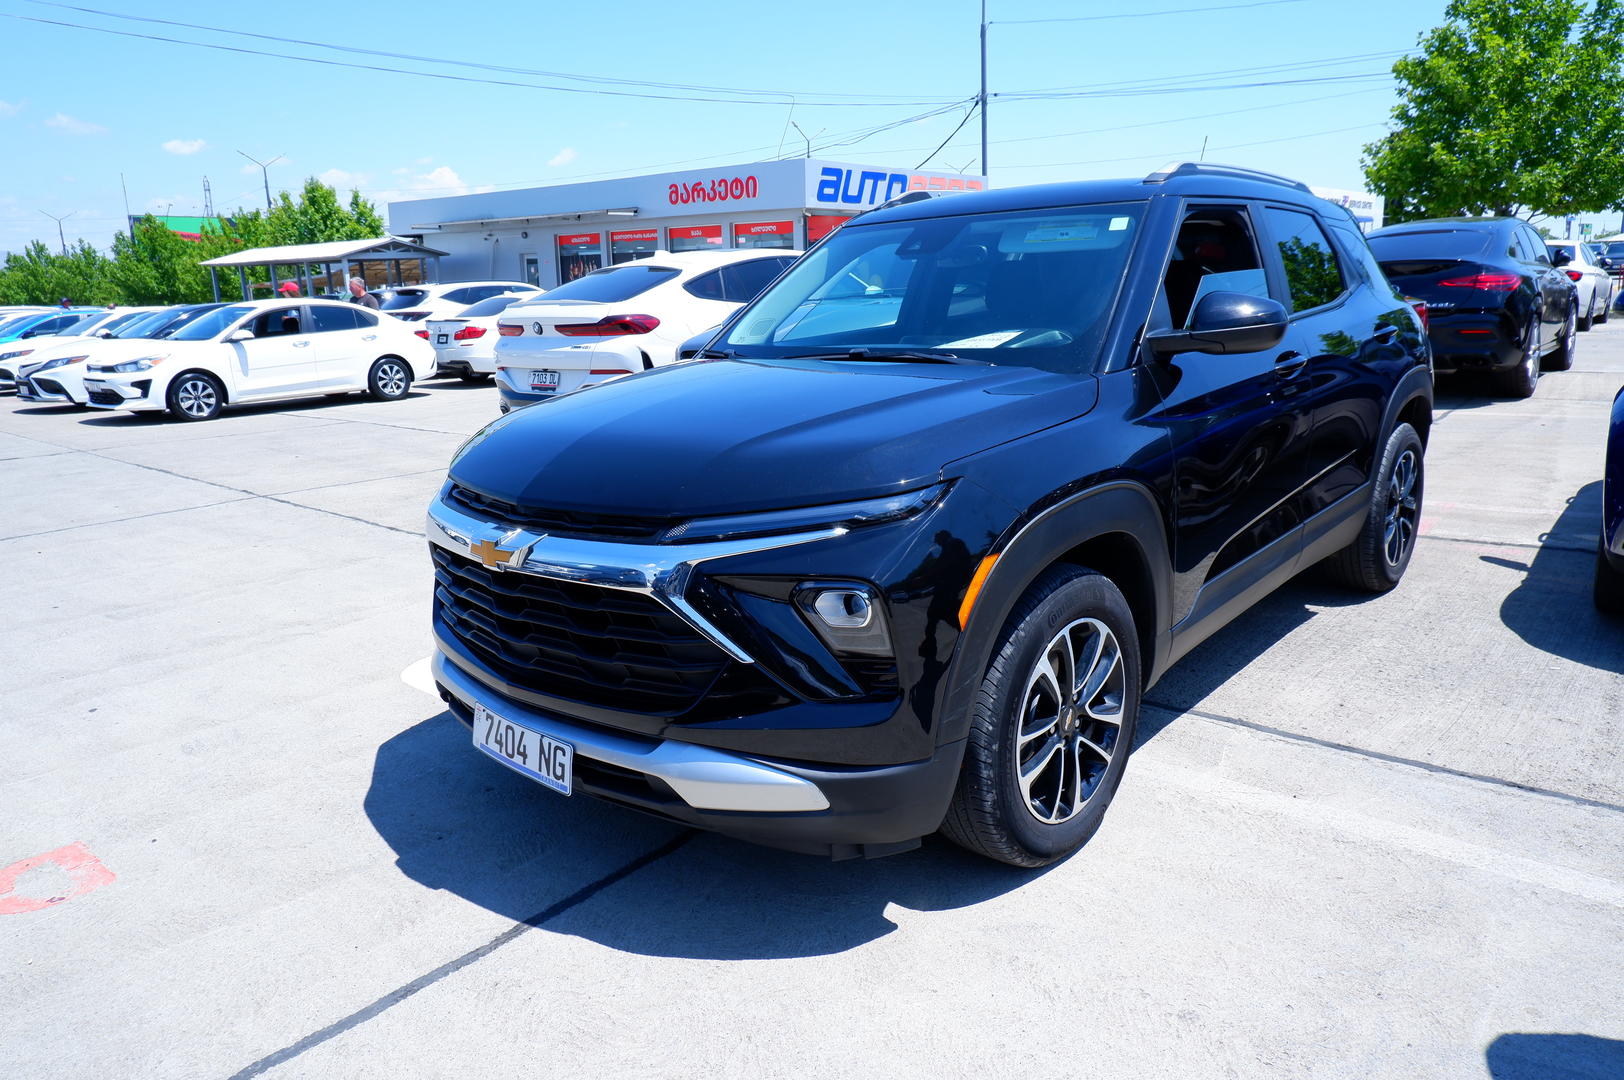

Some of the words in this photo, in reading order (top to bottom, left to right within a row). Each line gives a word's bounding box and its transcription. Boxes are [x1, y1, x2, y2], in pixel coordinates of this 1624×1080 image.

[668, 175, 759, 206] მარკეტი
[532, 373, 548, 384] 7103
[485, 713, 528, 766] 7404
[538, 738, 566, 782] NG
